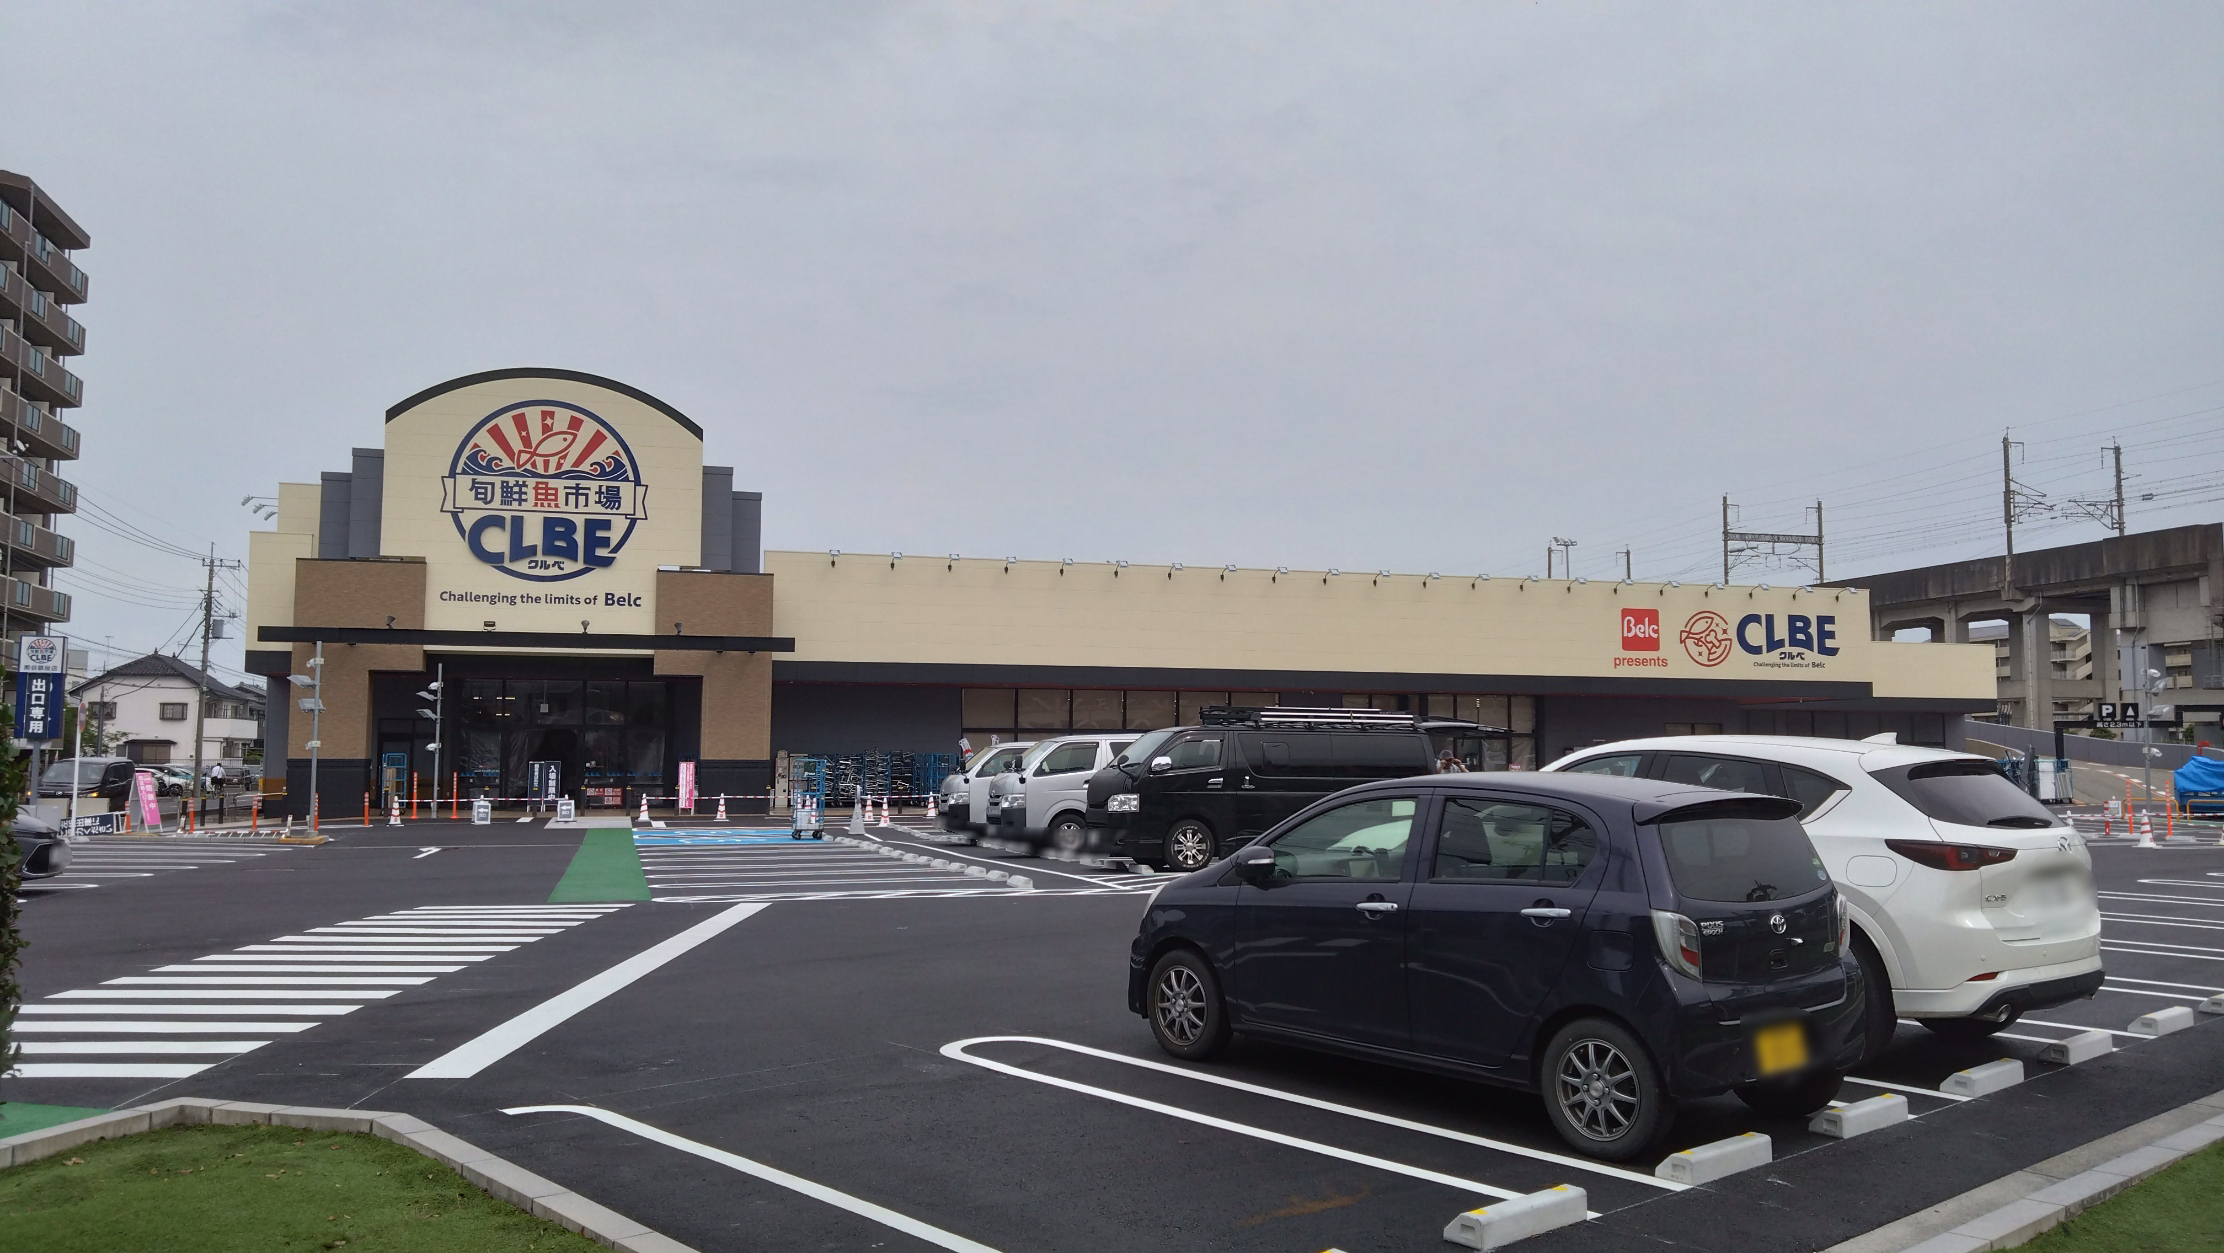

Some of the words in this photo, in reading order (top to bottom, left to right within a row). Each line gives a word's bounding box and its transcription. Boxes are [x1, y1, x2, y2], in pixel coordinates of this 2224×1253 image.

[468, 478, 622, 511] 旬鮮魚市場
[467, 514, 617, 568] CLBE
[527, 559, 565, 571] クルベ
[439, 591, 518, 605] Challenging
[520, 593, 542, 604] the
[545, 593, 581, 605] limits
[584, 594, 598, 605] of
[604, 592, 642, 607] Belc
[1623, 616, 1659, 638] Belc
[1736, 614, 1840, 656] CLBE
[30, 654, 53, 662] CLBE
[1613, 656, 1668, 669] presents
[1779, 651, 1805, 660] クルベ
[28, 679, 46, 734] 出口専用
[2102, 704, 2113, 716] P
